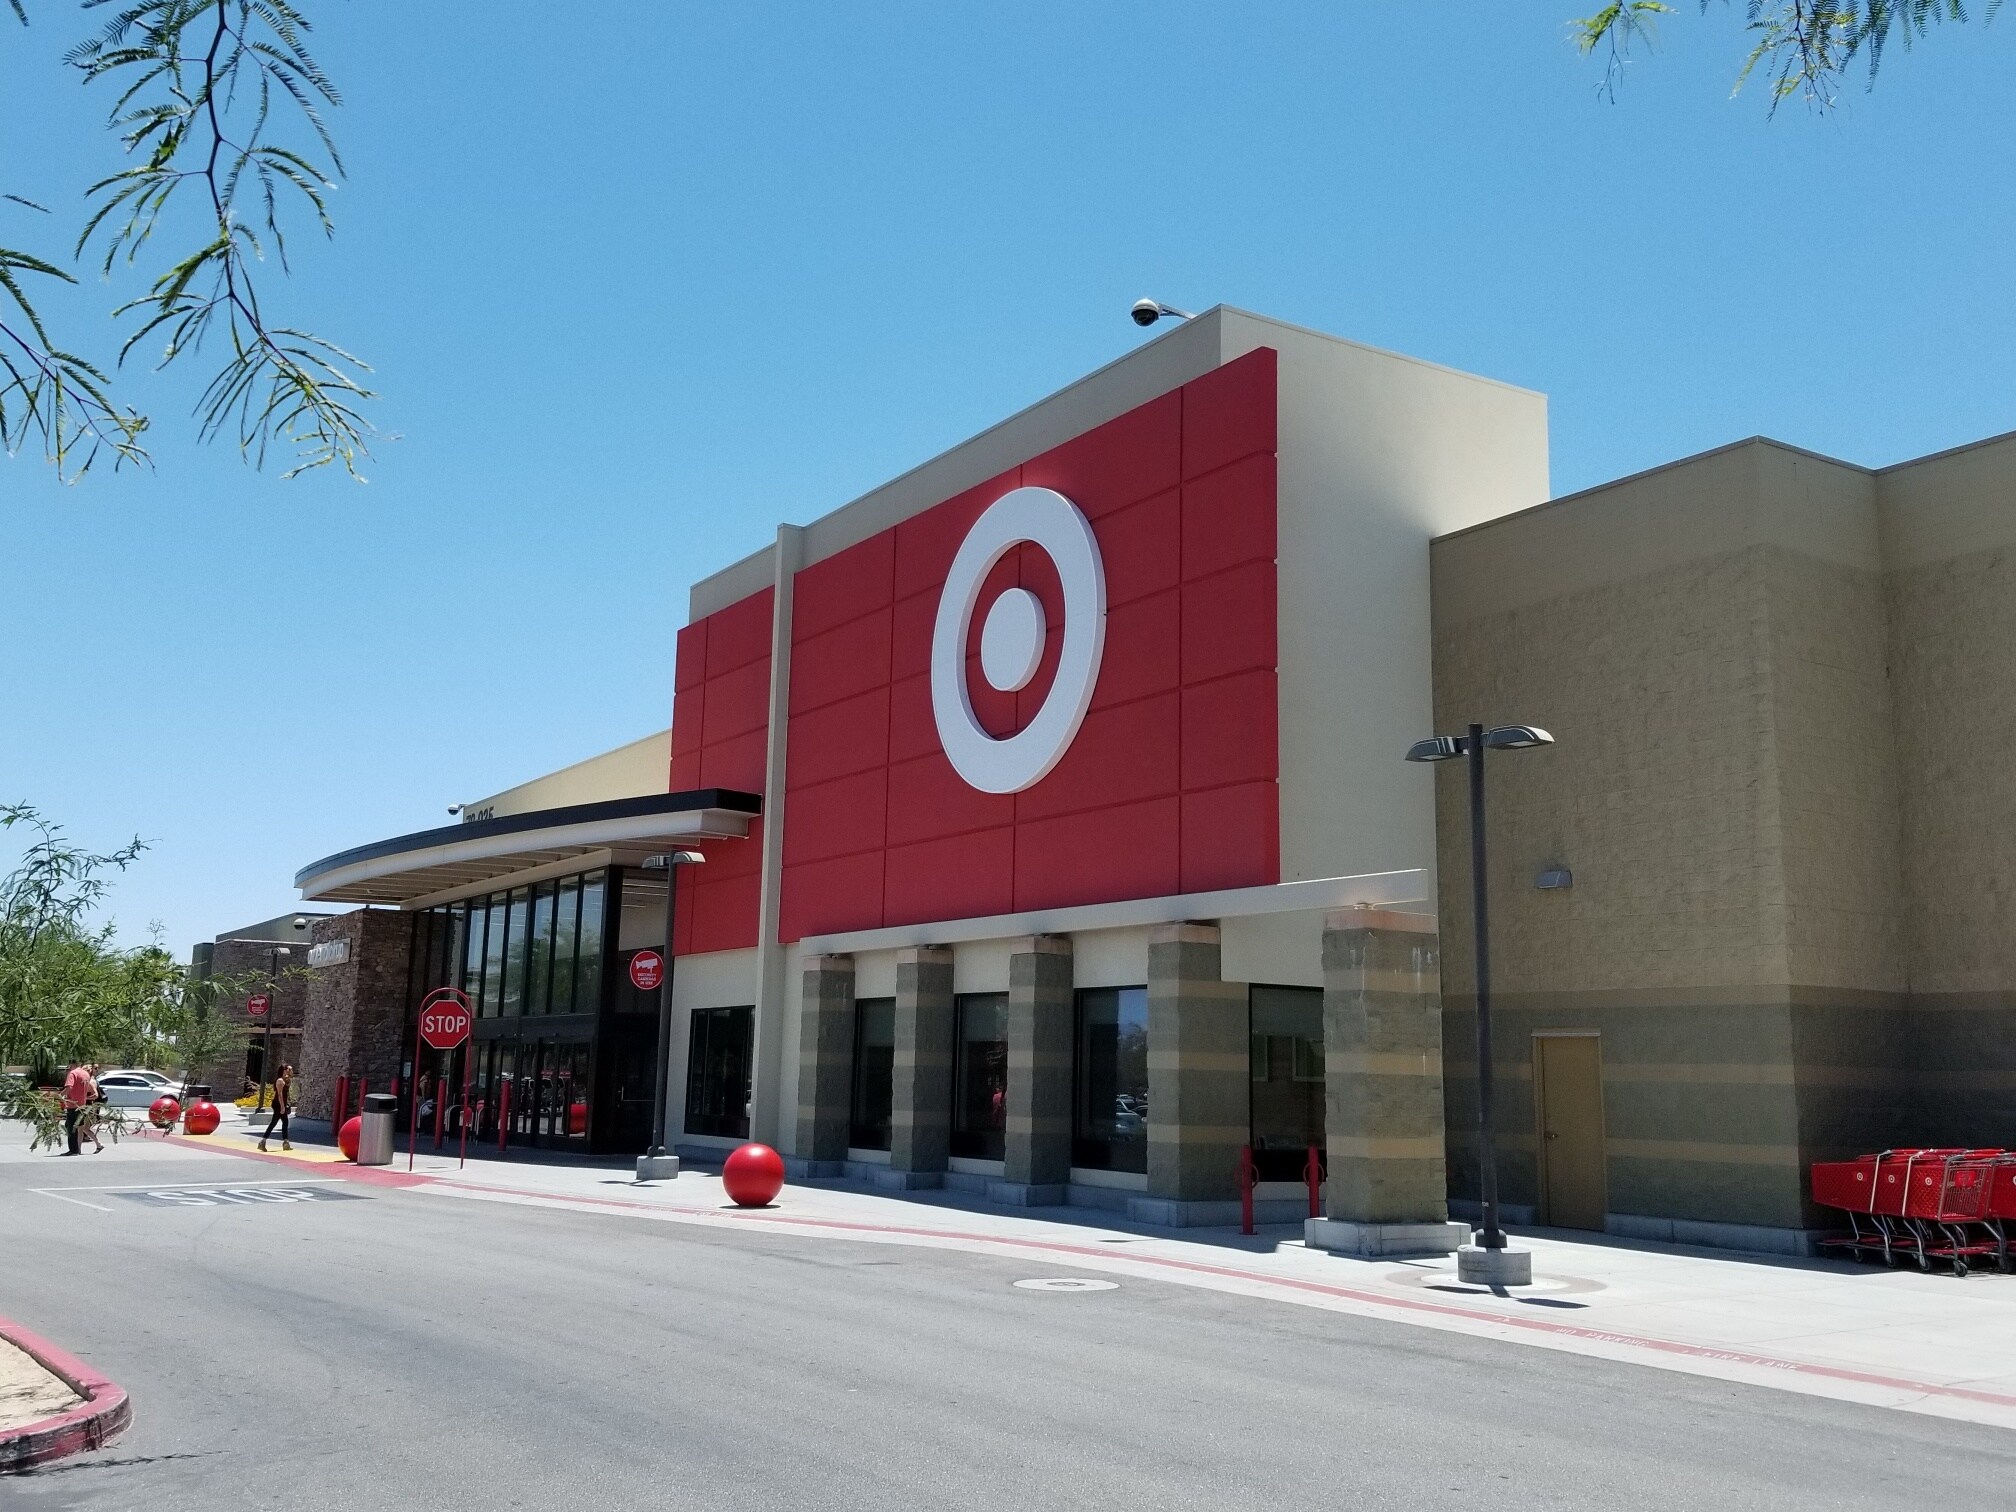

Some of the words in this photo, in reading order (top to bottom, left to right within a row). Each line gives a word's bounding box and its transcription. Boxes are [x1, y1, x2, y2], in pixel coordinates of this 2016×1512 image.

[425, 1015, 467, 1033] STOP
[147, 1188, 321, 1206] STOP
[1555, 1327, 1577, 1335] NO
